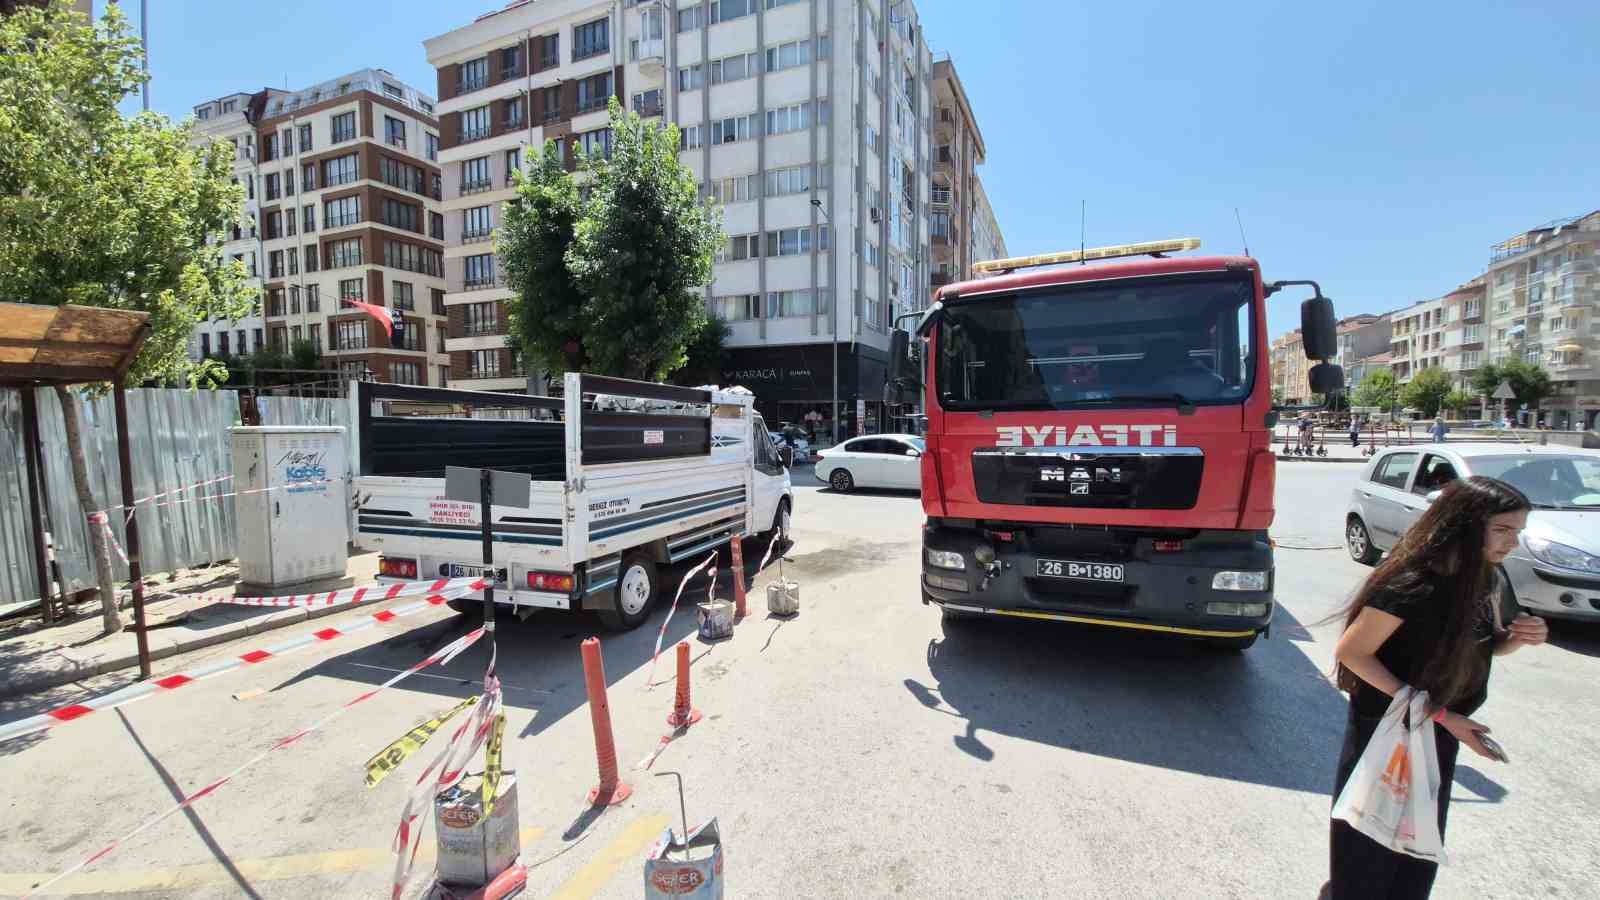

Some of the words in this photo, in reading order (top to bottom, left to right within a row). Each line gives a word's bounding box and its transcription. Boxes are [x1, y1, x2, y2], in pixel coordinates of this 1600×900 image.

[735, 369, 777, 379] KARACA
[1040, 467, 1120, 482] MAN
[1044, 561, 1062, 575] 26
